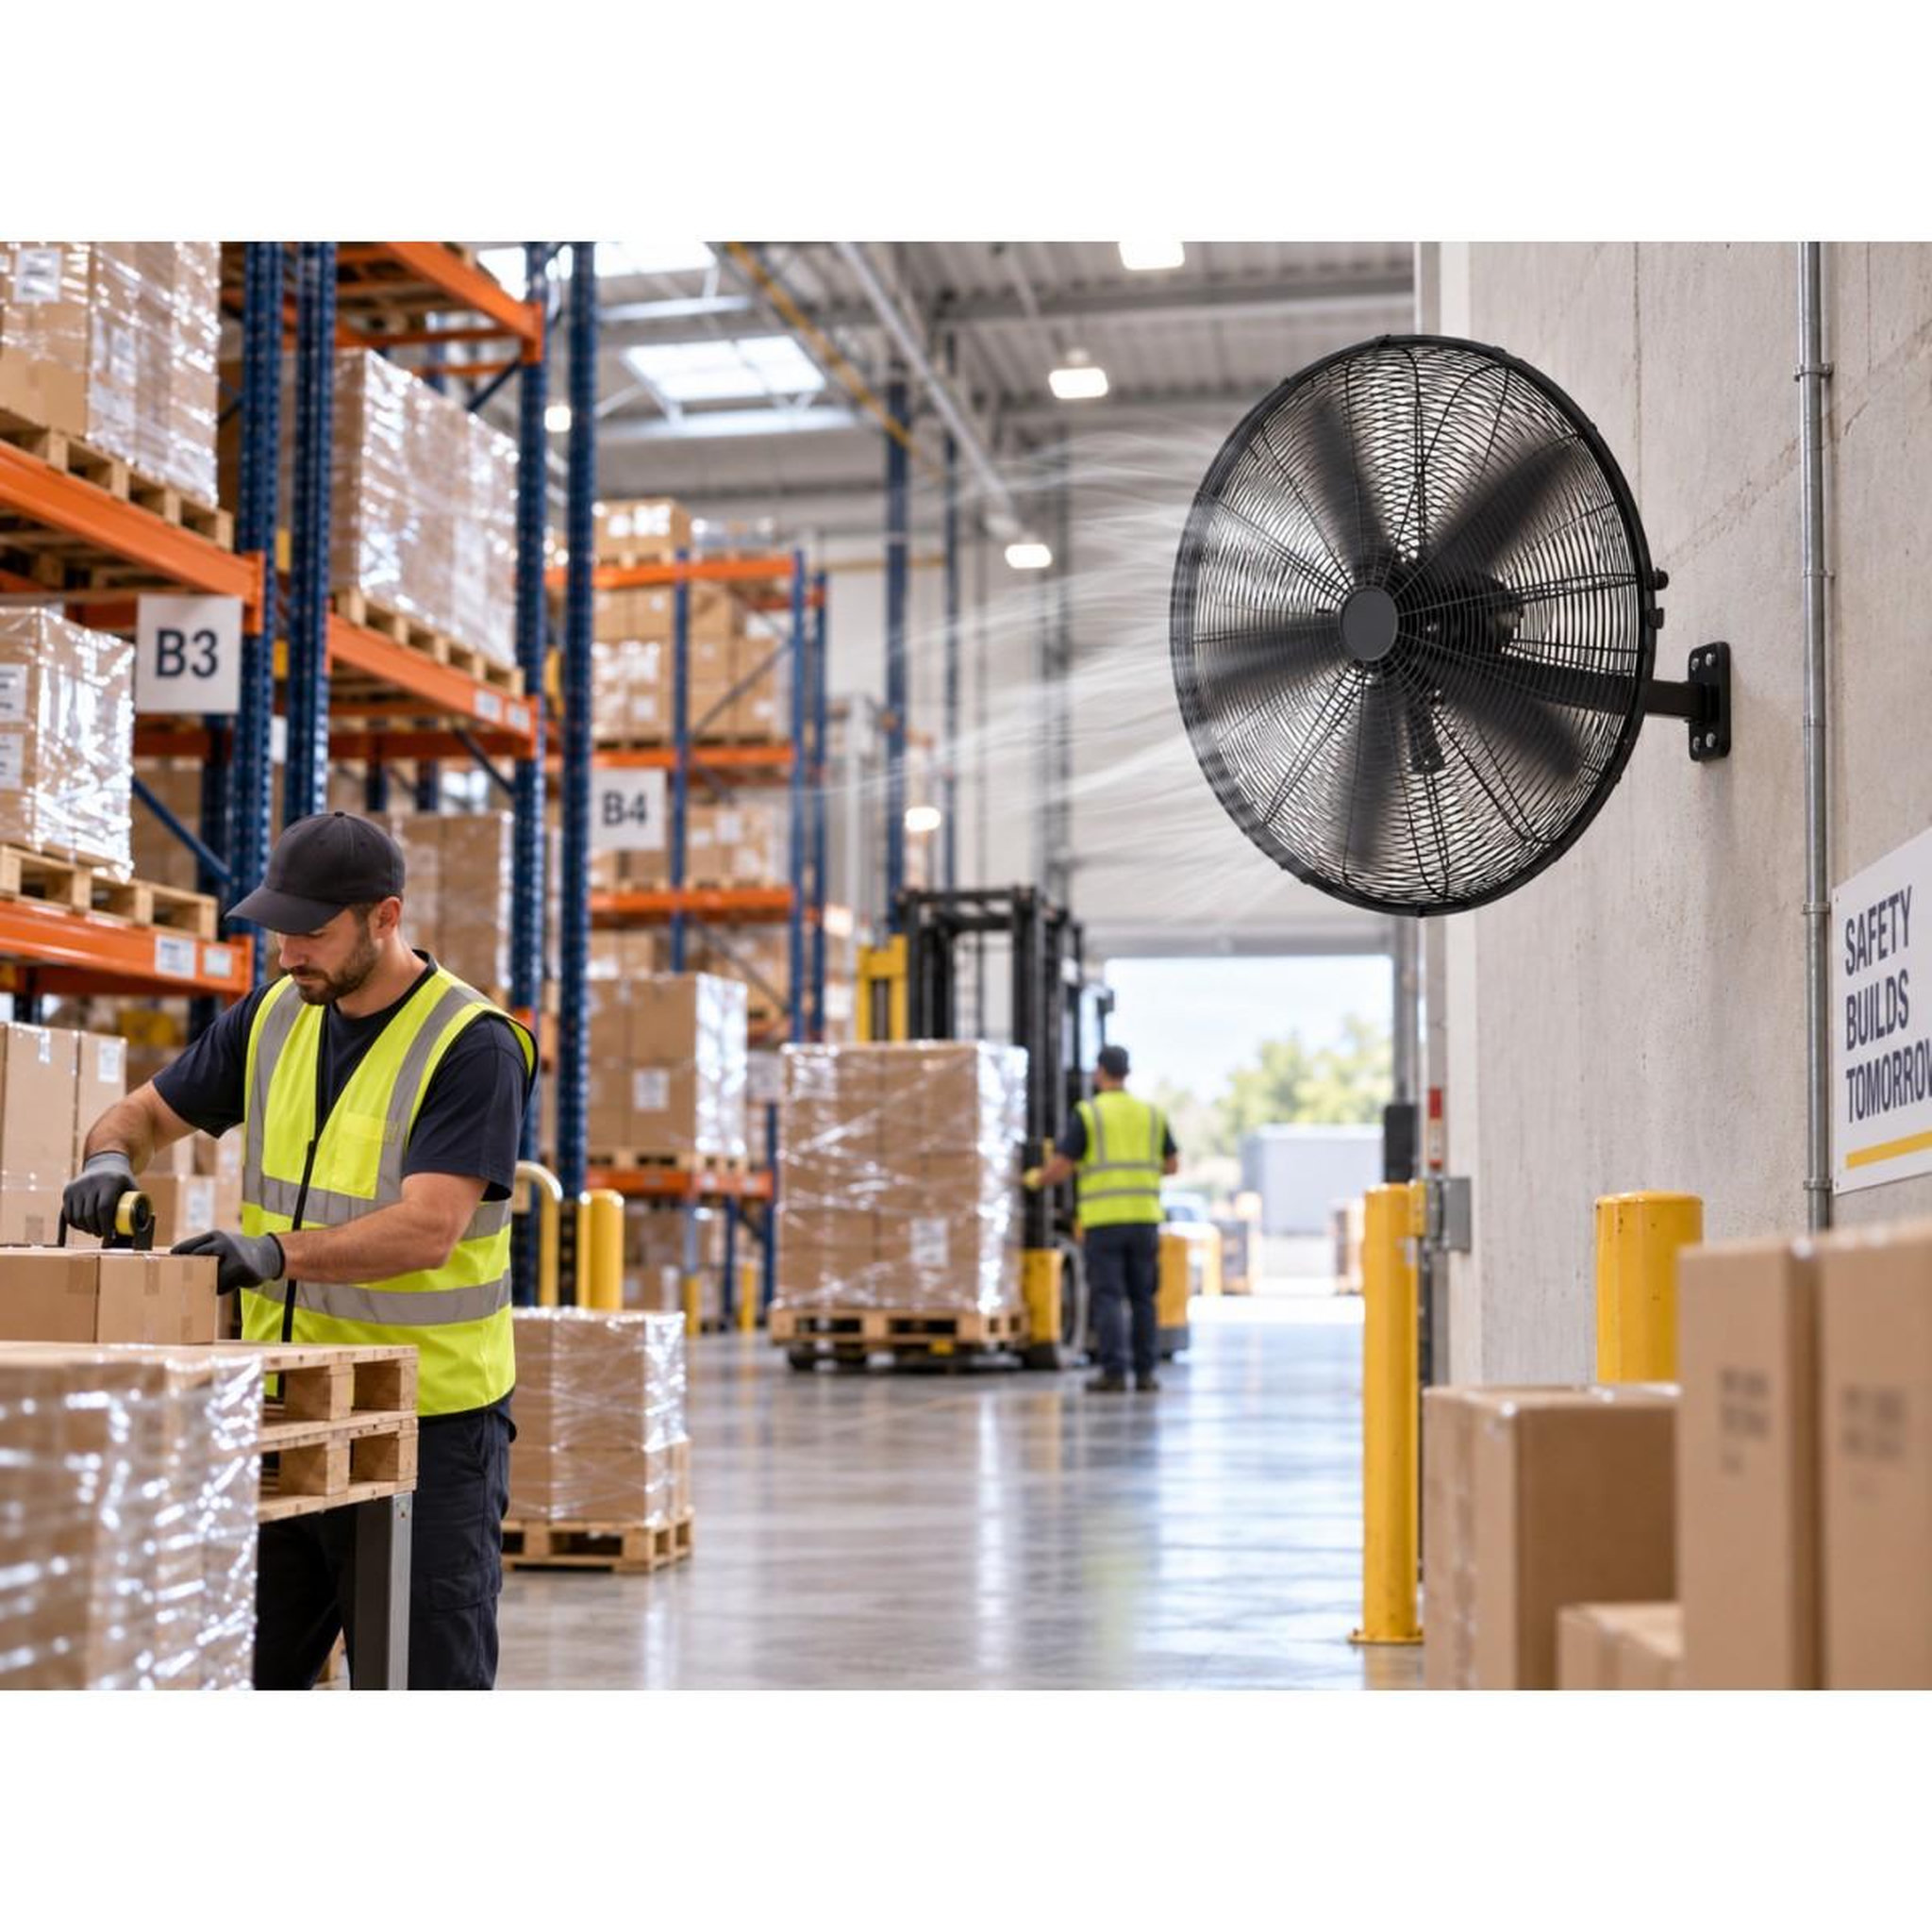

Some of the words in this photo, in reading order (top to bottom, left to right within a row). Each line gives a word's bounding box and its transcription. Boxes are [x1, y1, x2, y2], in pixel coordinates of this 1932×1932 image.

[156, 629, 218, 678] B3
[603, 791, 646, 826] B4
[1845, 885, 1912, 976] SAFETY
[1846, 968, 1909, 1051] BUILDS
